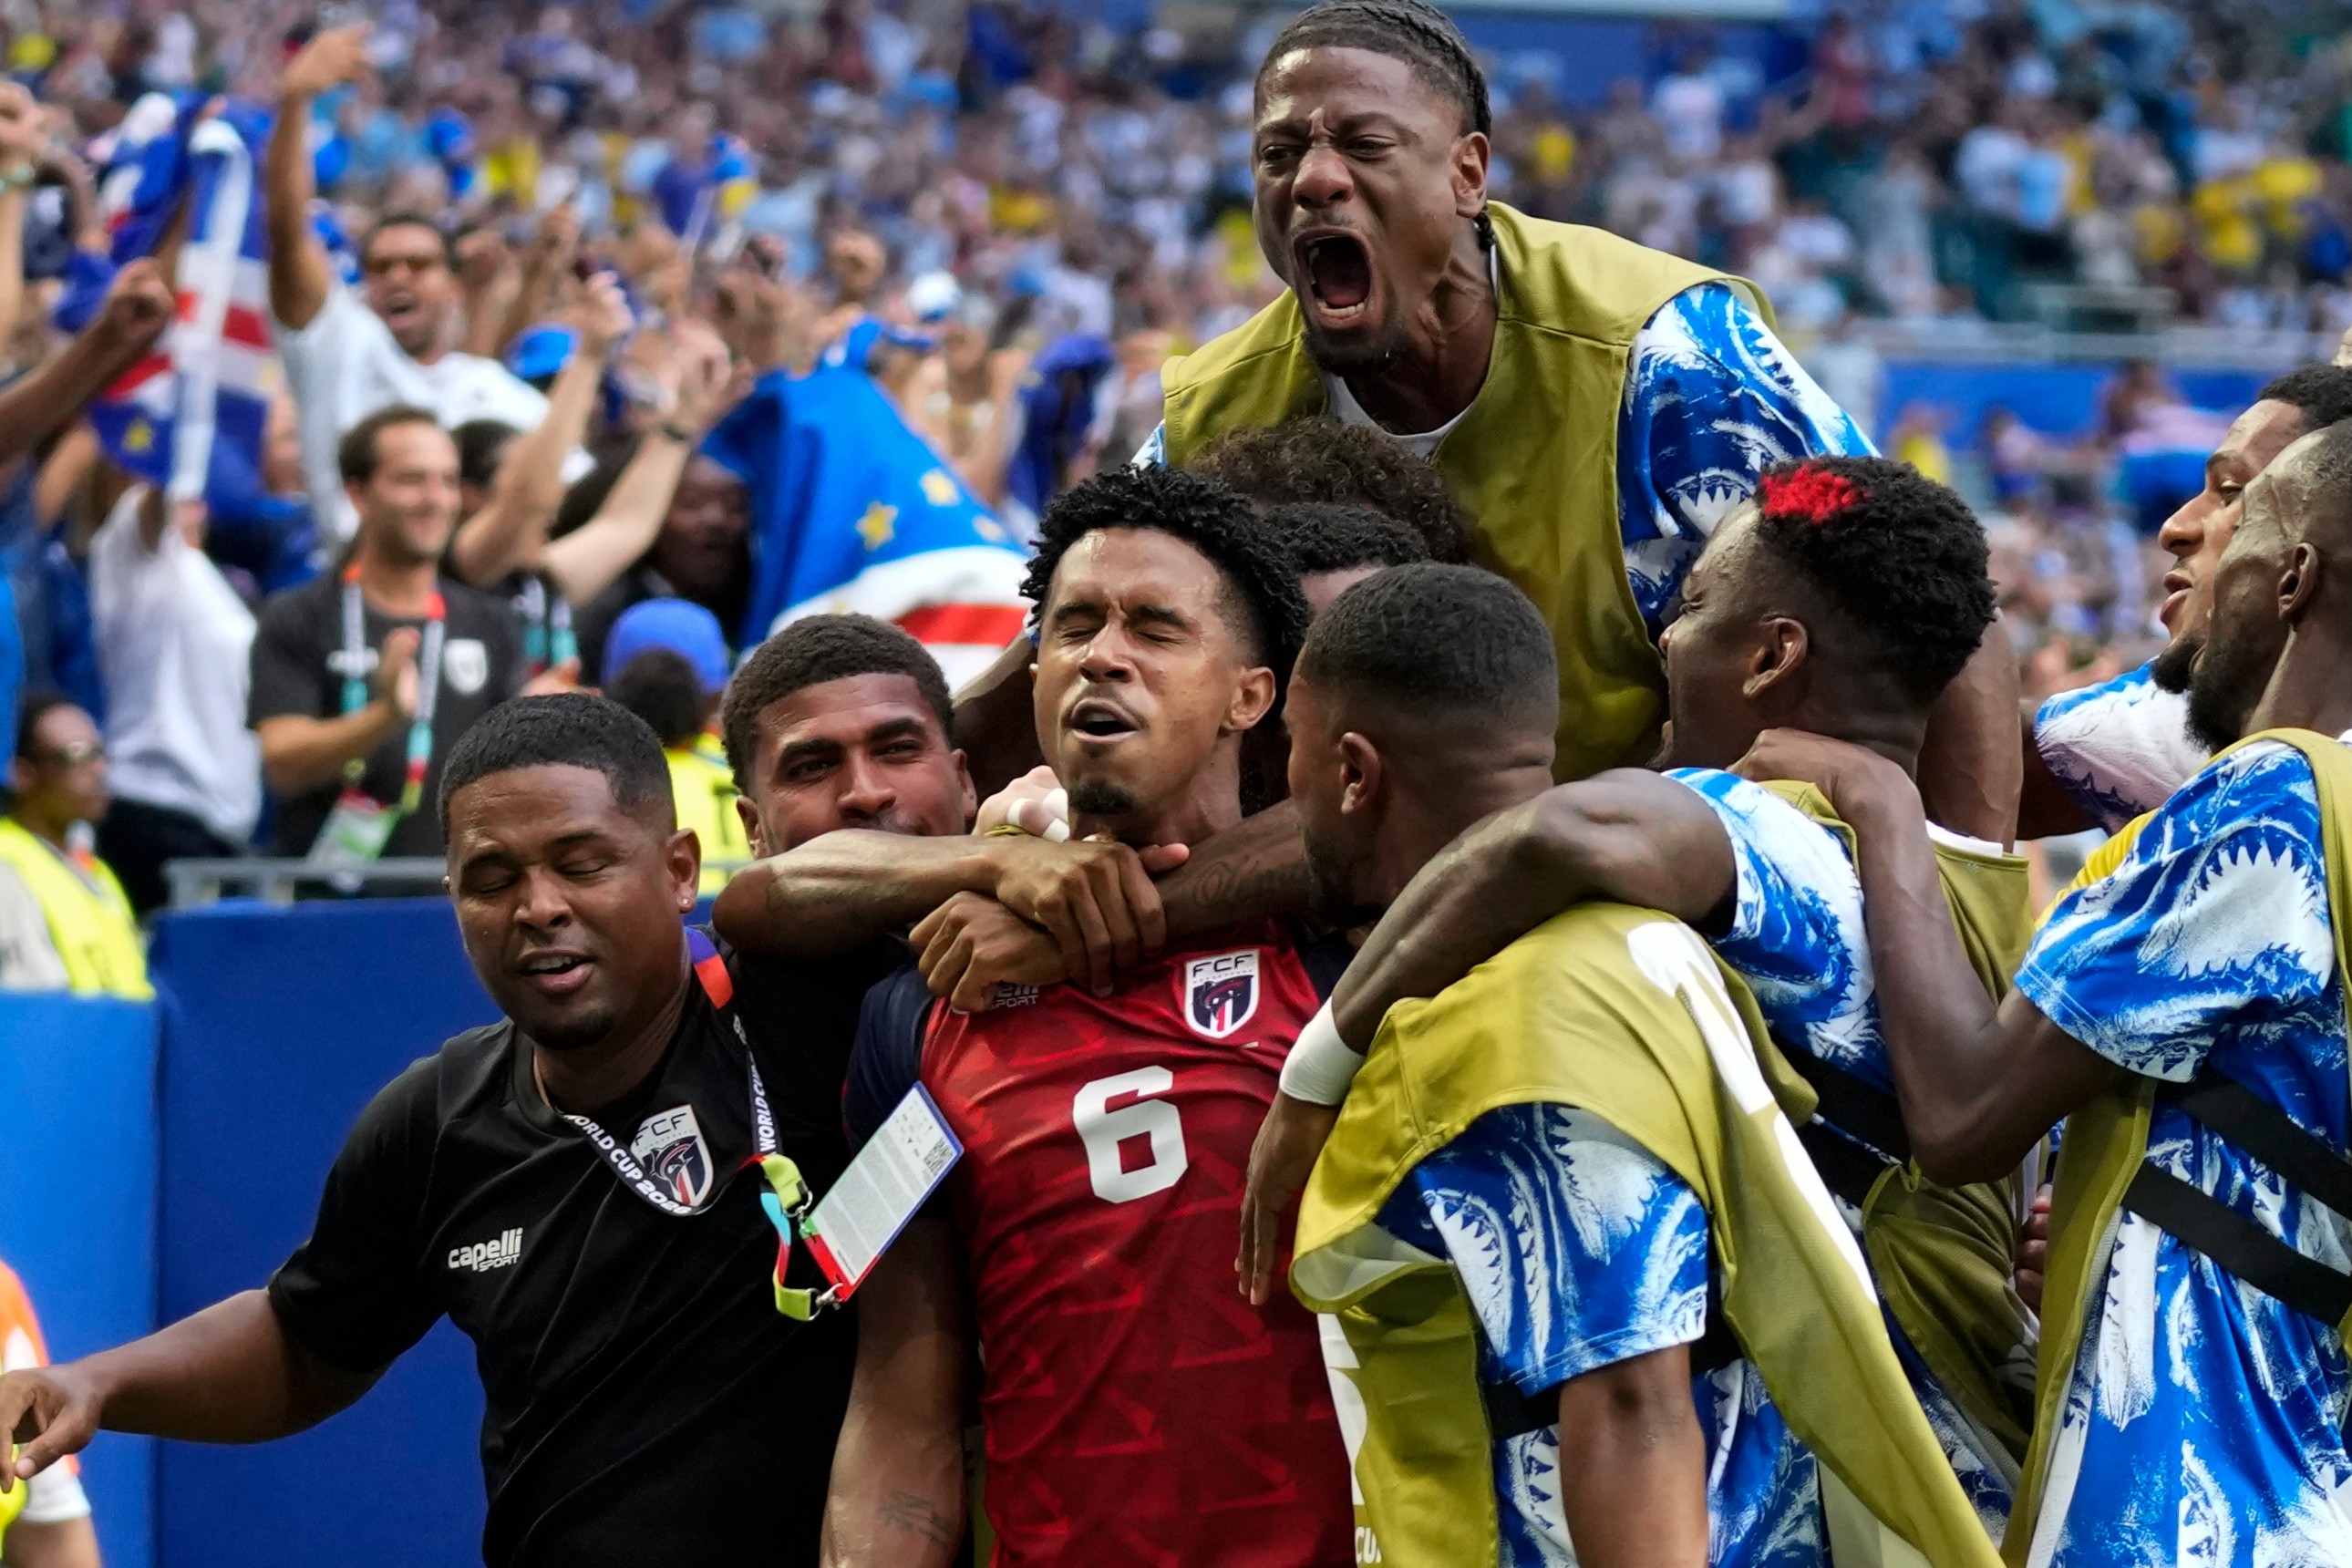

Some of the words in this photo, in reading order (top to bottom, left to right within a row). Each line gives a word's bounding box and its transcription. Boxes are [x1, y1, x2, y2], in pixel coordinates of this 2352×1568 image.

[1192, 954, 1253, 977] FCF
[634, 1112, 687, 1147] FCF
[755, 1098, 777, 1152] WORLD
[1072, 1064, 1189, 1204] 6
[609, 1148, 644, 1181] CUP
[635, 1179, 693, 1214] 2026
[448, 1226, 524, 1272] capelli
[478, 1253, 521, 1273] SPORT
